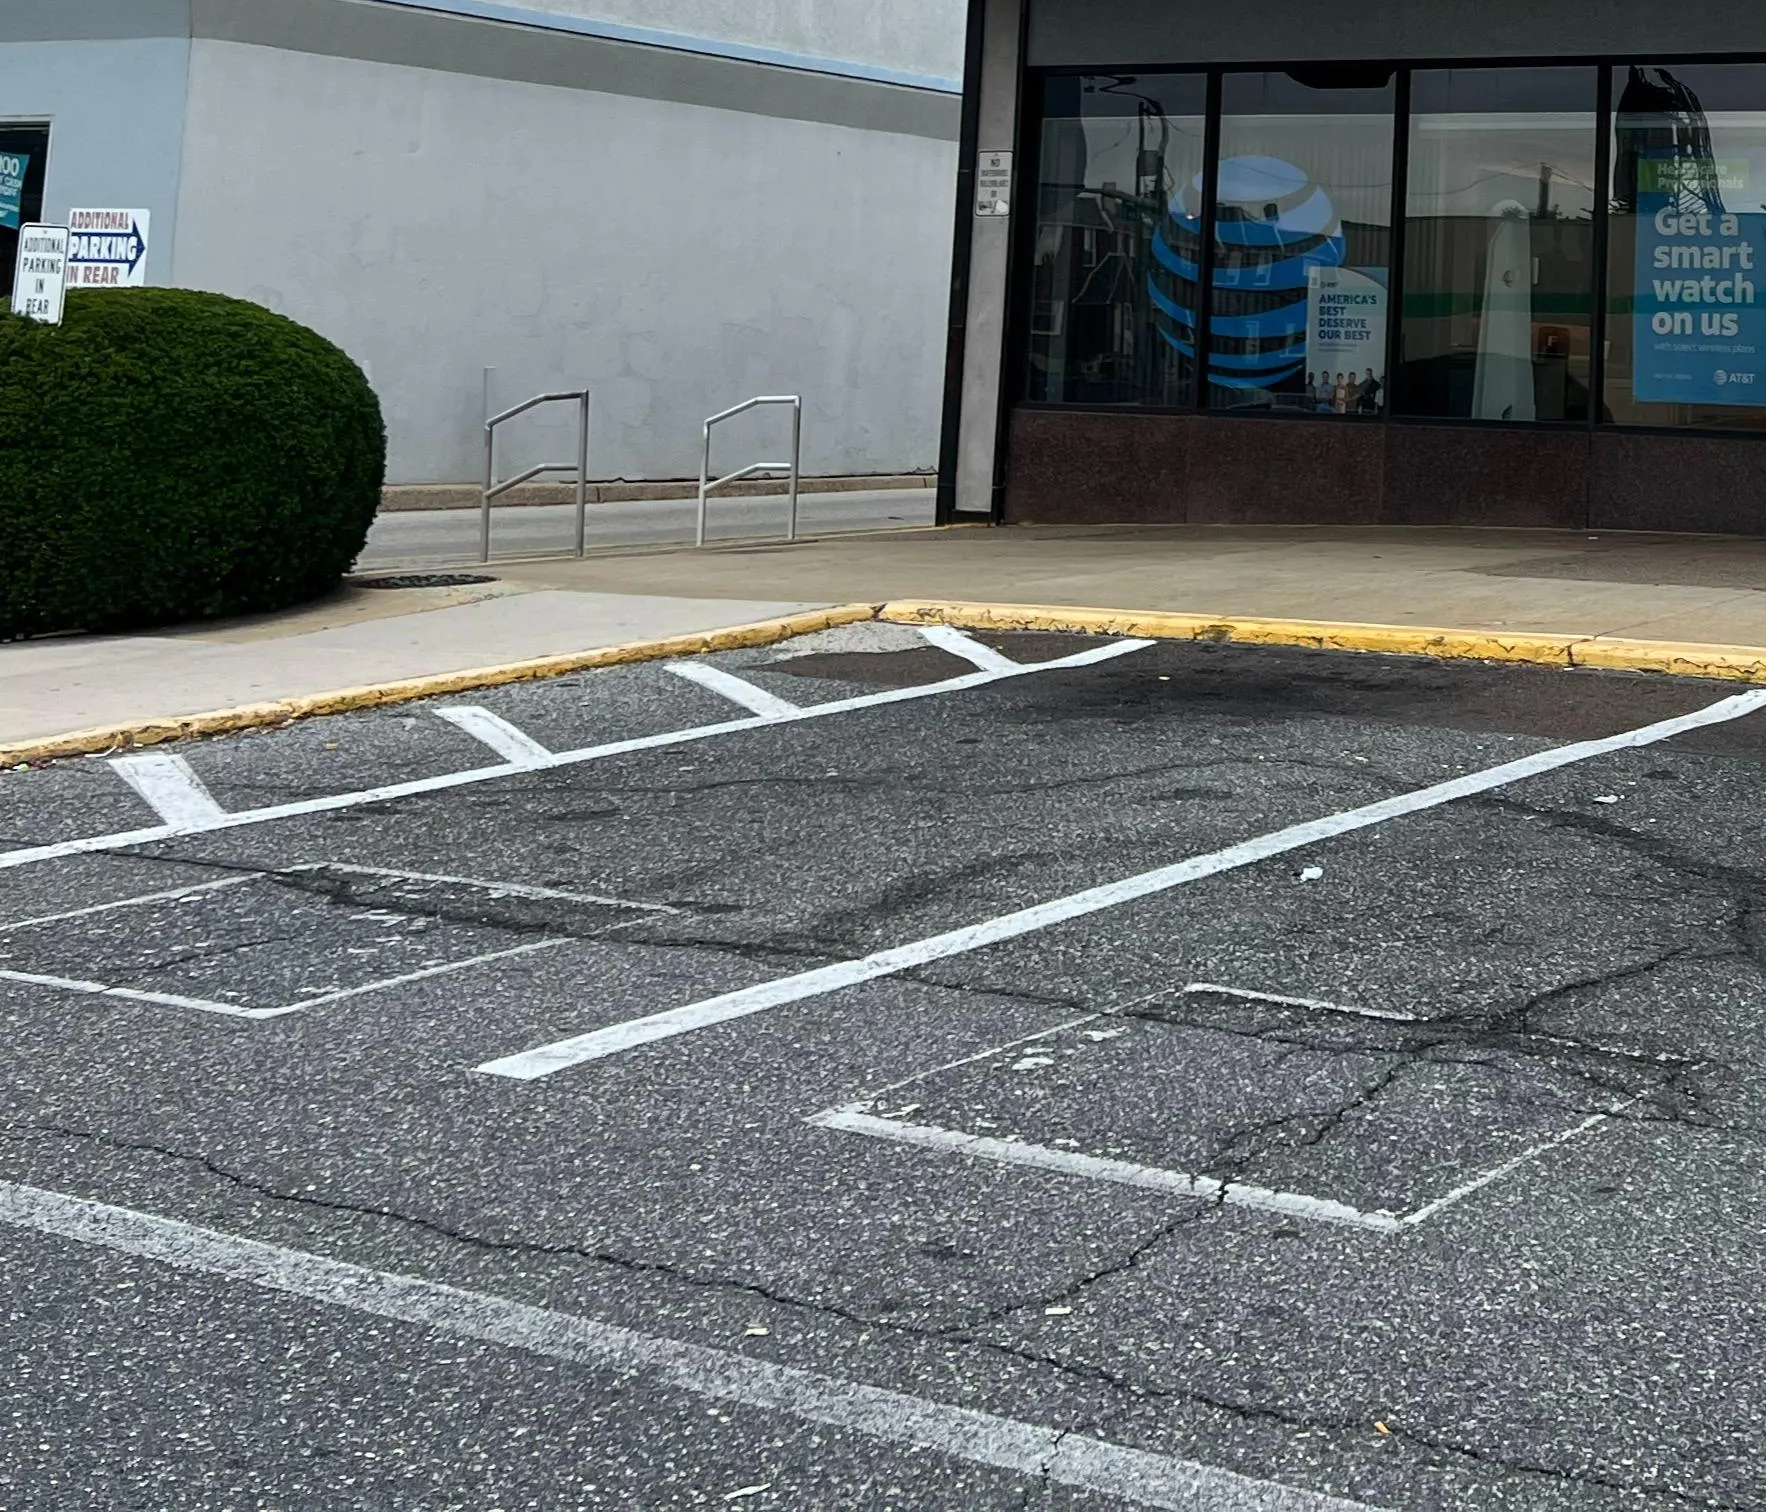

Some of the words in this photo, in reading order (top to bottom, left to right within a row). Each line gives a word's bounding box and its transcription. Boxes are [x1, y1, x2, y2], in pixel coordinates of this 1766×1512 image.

[71, 211, 129, 229] ADDITIONAL
[1654, 206, 1713, 236] Get
[1719, 213, 1739, 236] a
[24, 237, 65, 254] ADDITIONAL
[69, 235, 138, 261] PARKING
[1653, 241, 1754, 270] smart
[23, 257, 62, 275] PARKING
[66, 265, 79, 284] IN
[83, 266, 120, 285] REAR
[35, 278, 44, 294] IN
[1652, 272, 1755, 304] watch
[25, 298, 49, 315] REAR
[1319, 294, 1377, 305] AMERICA'S
[1318, 306, 1347, 316] BEST
[1318, 318, 1368, 328] DESERVE
[1651, 311, 1693, 336] on
[1701, 311, 1739, 337] us
[1318, 329, 1341, 340] OUR
[1343, 330, 1372, 341] BEST
[1728, 372, 1757, 384] AT&T
